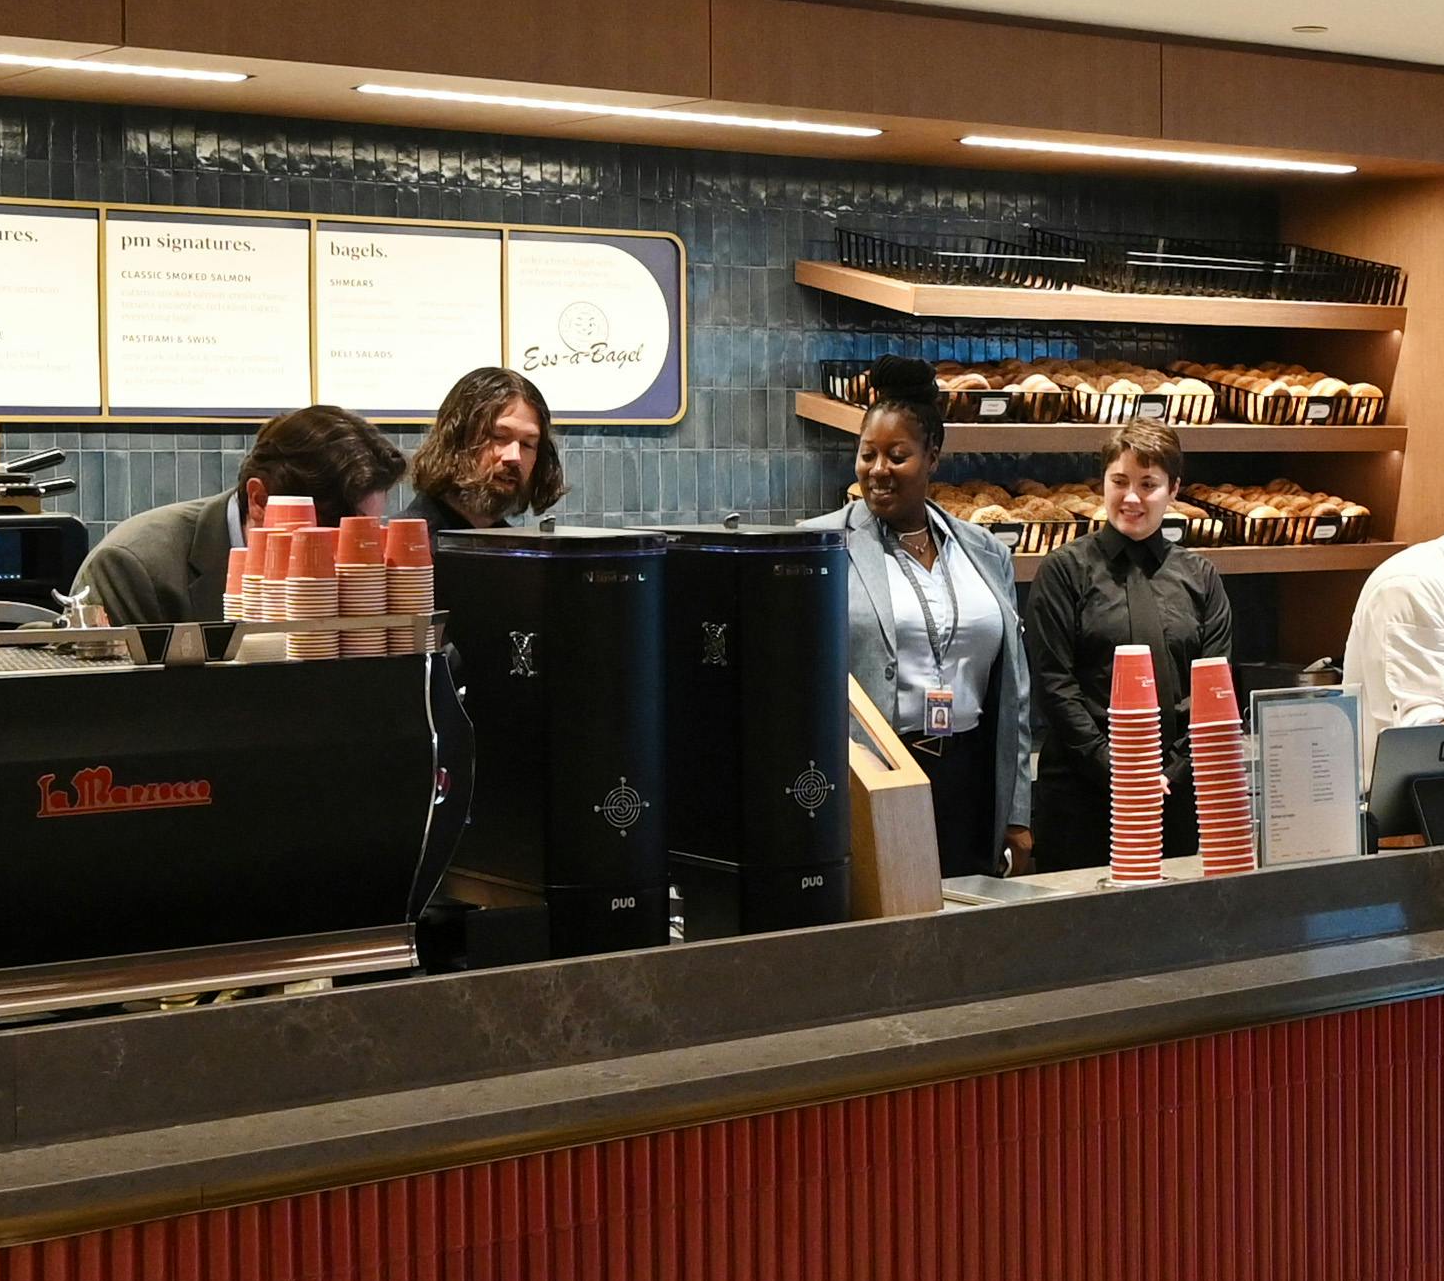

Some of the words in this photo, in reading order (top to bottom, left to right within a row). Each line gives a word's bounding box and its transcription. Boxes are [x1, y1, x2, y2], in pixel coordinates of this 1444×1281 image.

[120, 235, 151, 251] pm
[156, 233, 257, 253] signatures.
[330, 240, 388, 261] bagels.
[120, 270, 163, 280] CLASSIC
[165, 271, 207, 281] SMOKED
[210, 273, 252, 282] SALMON
[330, 279, 374, 288] SHMEARS
[122, 334, 173, 344] PASTRAMI
[176, 336, 183, 344] &
[187, 335, 217, 344] SWISS
[330, 350, 354, 359] DELI
[355, 350, 394, 359] SALADS
[523, 341, 644, 372] Ess-a-Bagel
